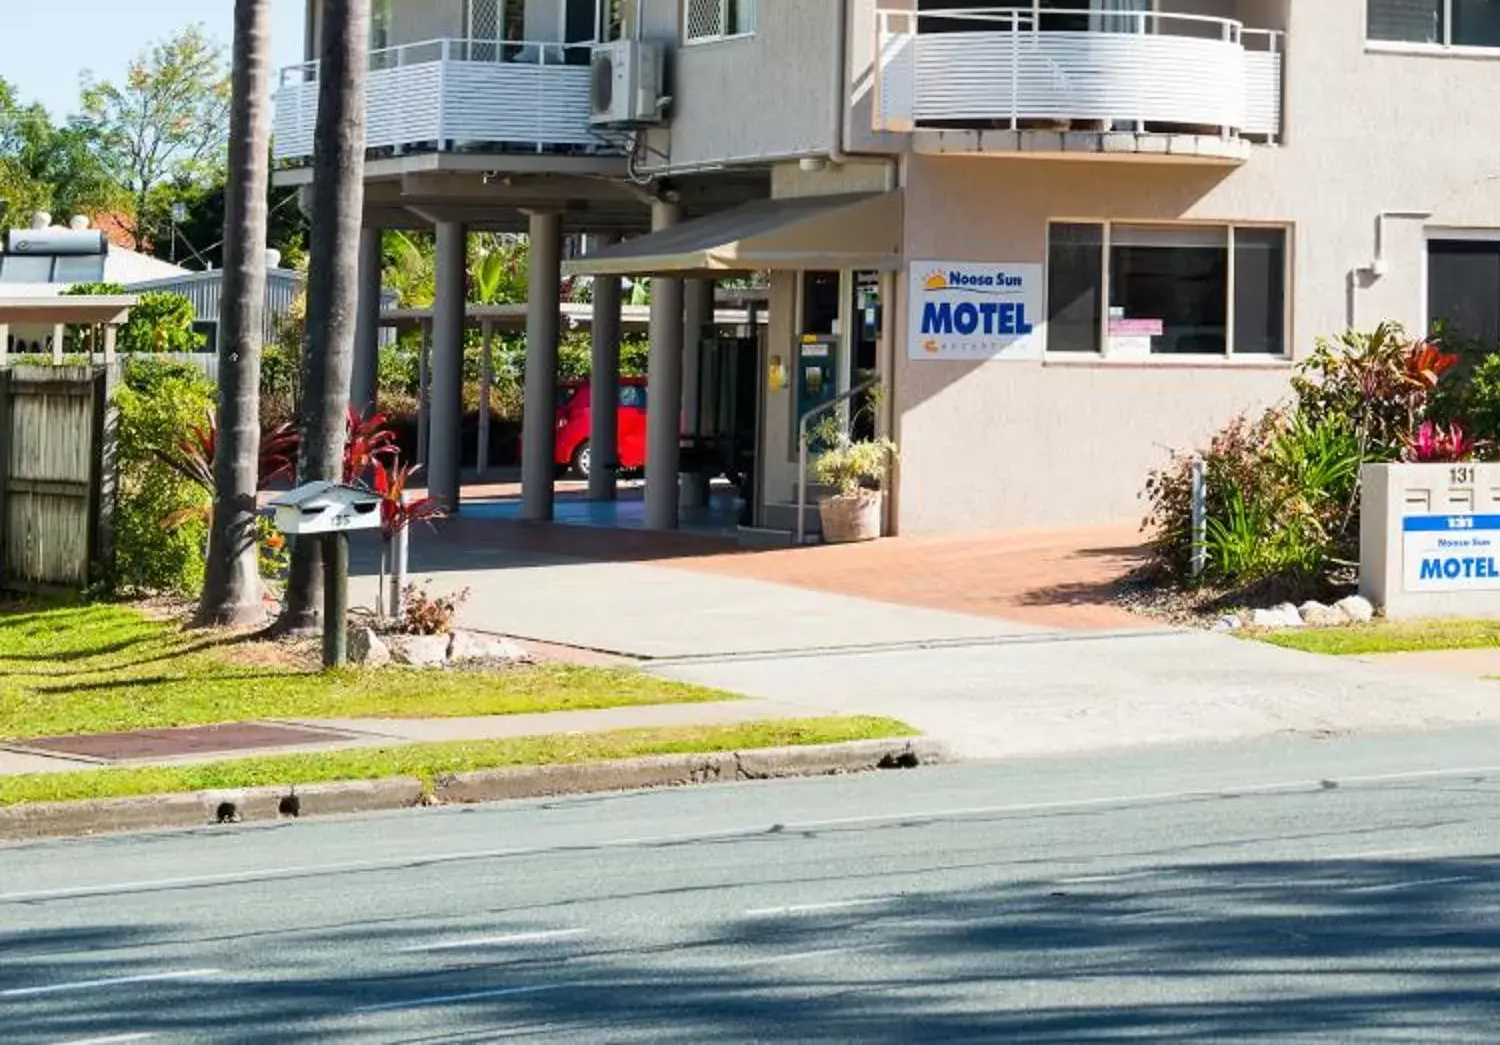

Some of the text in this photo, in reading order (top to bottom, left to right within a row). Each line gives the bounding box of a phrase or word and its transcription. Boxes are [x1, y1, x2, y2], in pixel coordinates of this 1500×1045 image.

[949, 271, 1023, 286] Noosa Sun
[921, 302, 1033, 335] MOTEL
[1450, 467, 1475, 484] 131
[1420, 557, 1499, 580] MOTEL
